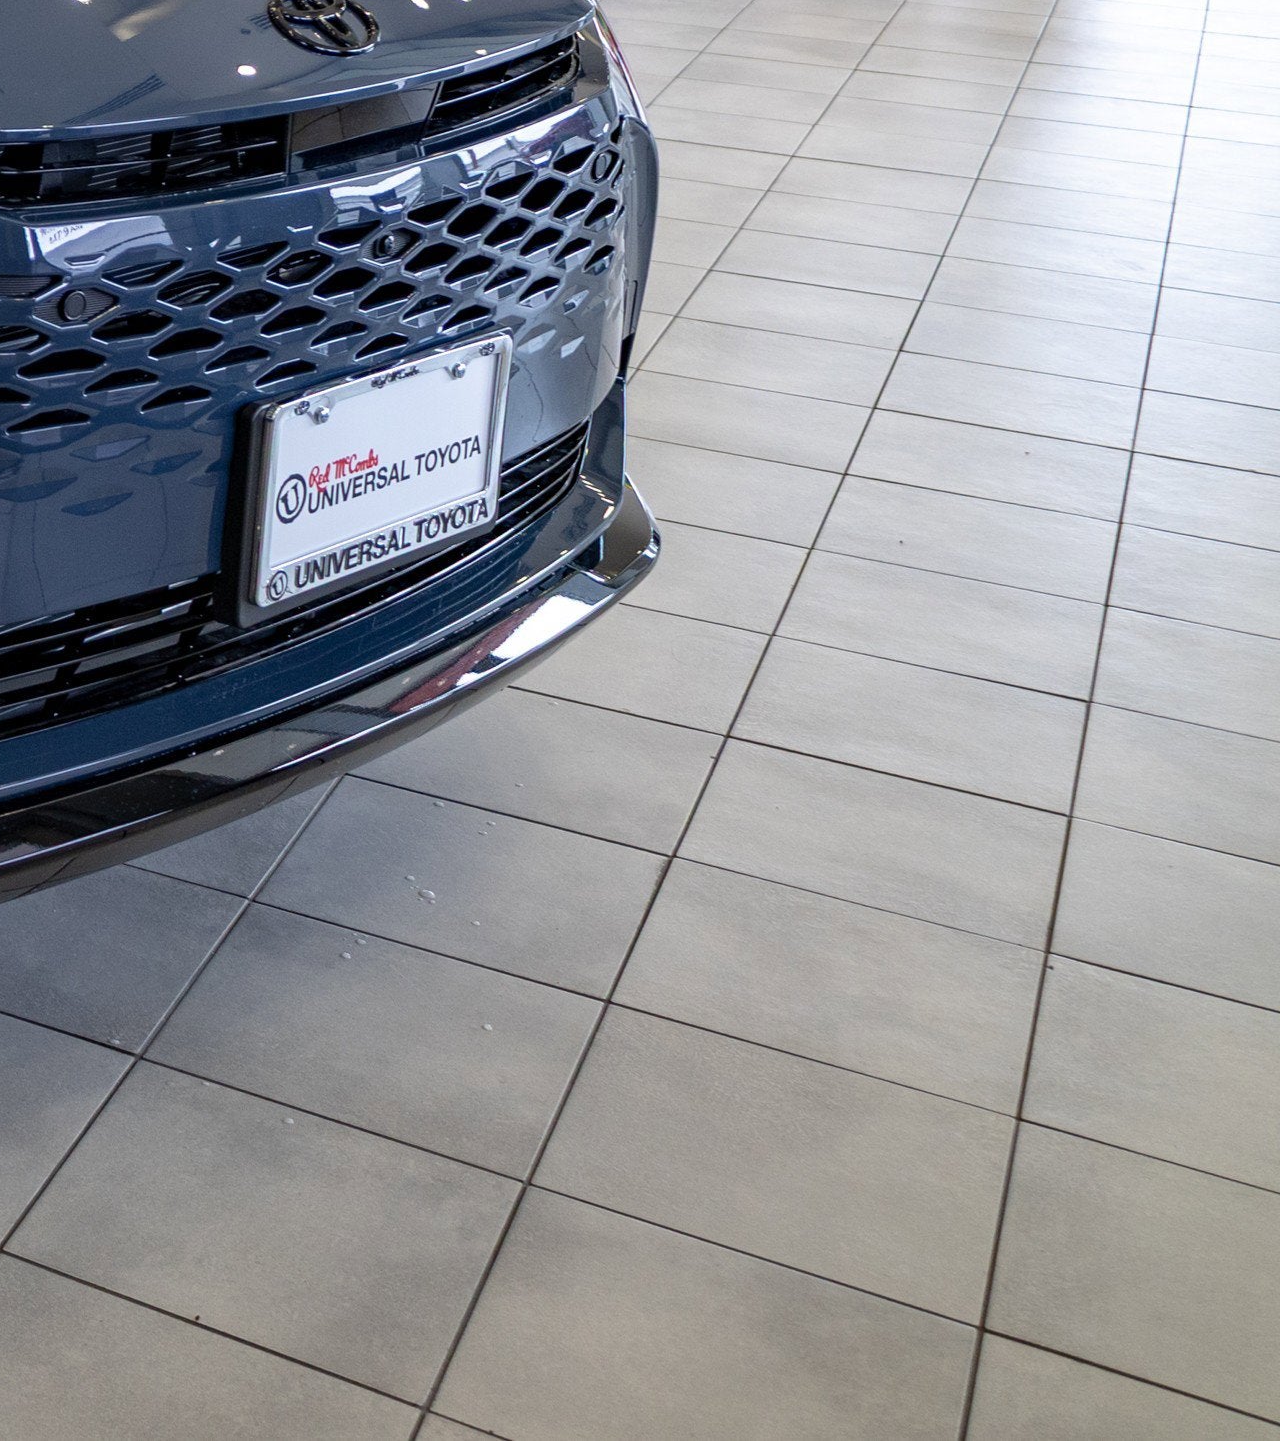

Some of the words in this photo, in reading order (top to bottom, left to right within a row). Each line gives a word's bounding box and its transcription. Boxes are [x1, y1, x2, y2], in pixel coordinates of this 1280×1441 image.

[308, 464, 410, 513] UNIVERSAL
[414, 435, 482, 476] TOYOTA
[308, 465, 331, 492] Red
[294, 526, 411, 588] UNIVERSAL
[413, 498, 489, 543] TOYOTA
